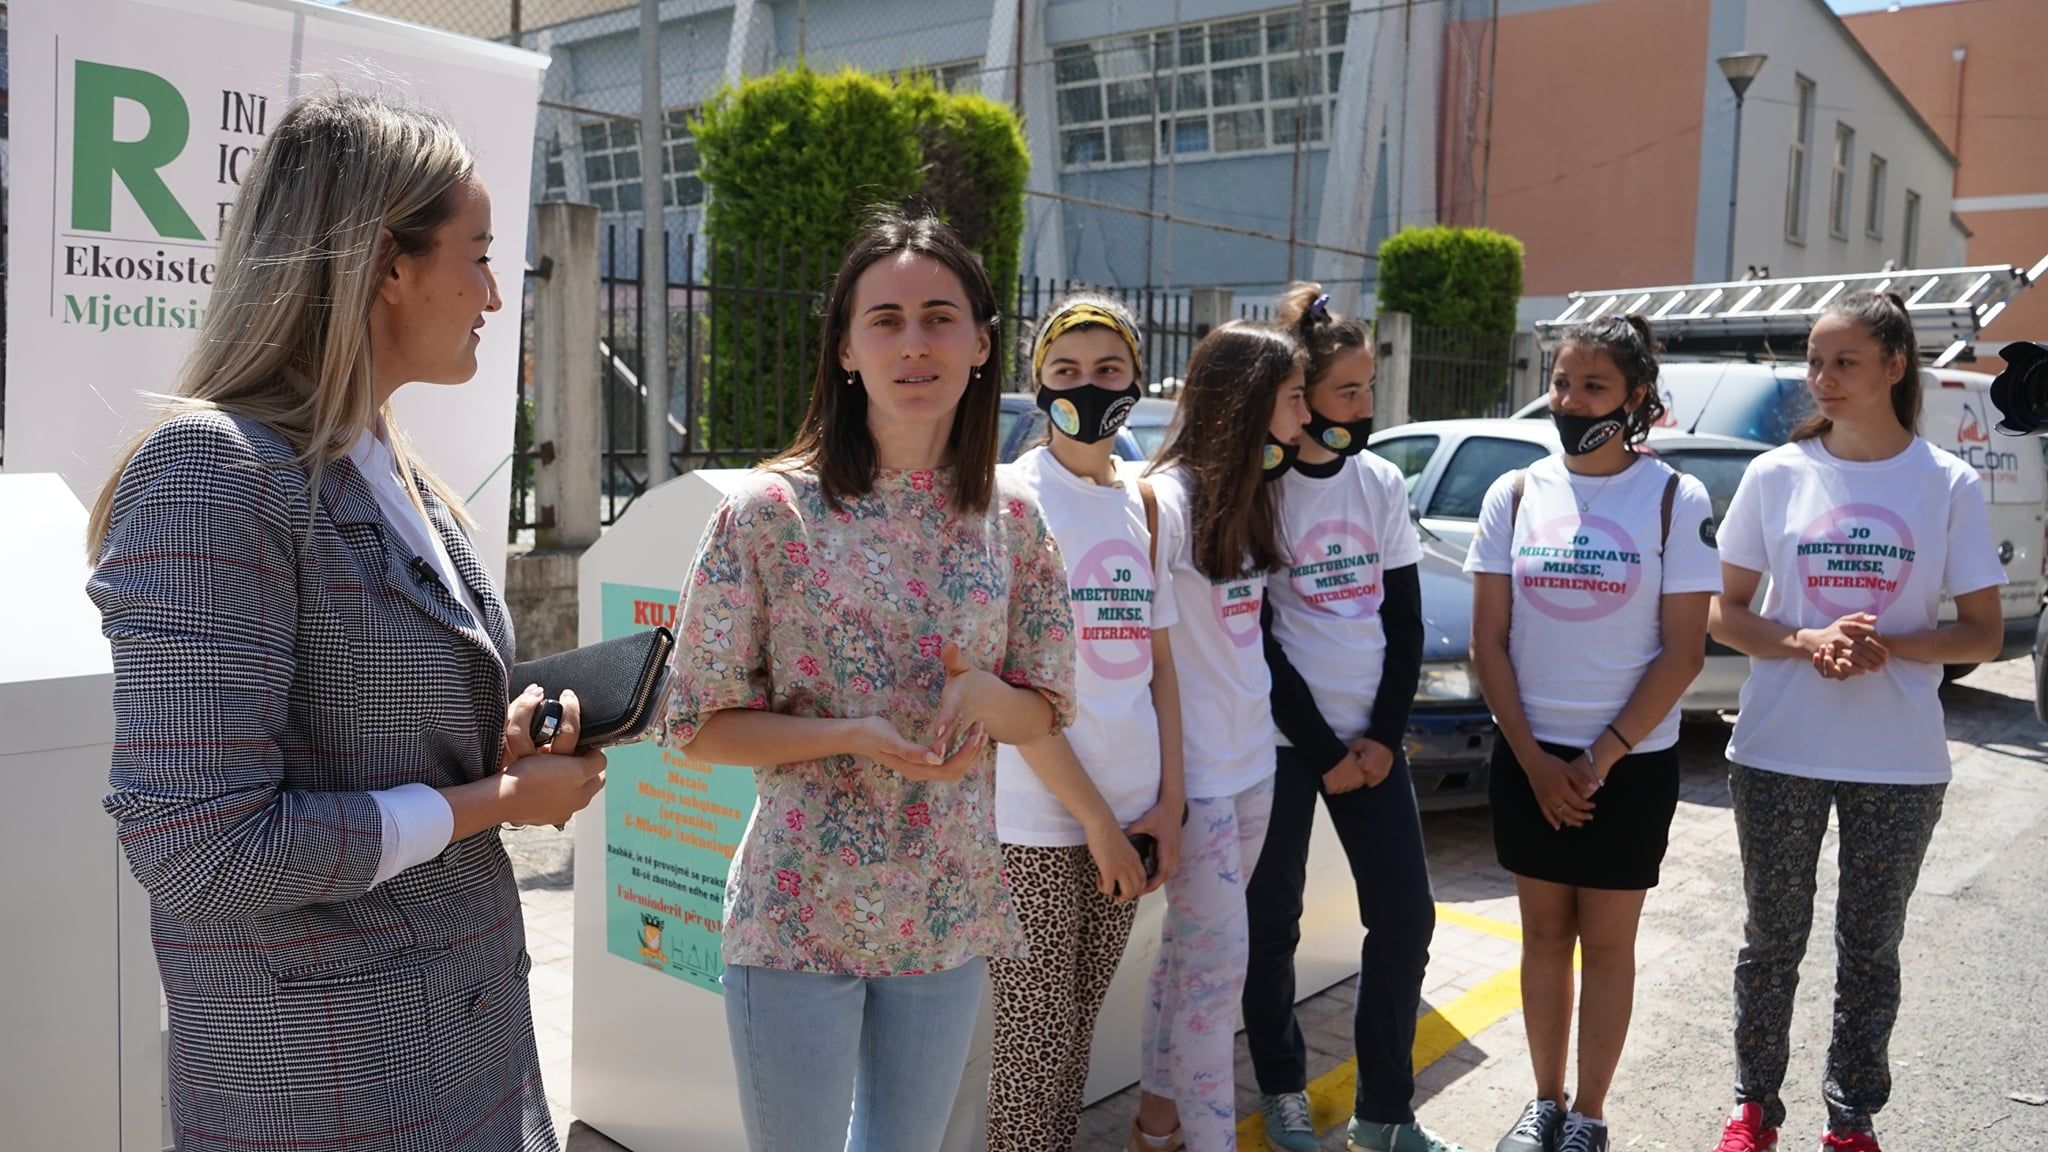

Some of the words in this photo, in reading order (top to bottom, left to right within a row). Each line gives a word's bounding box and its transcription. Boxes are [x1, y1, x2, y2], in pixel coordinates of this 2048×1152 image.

[71, 59, 207, 241] R
[217, 144, 261, 186] IC
[1568, 535, 1589, 545] JO
[1848, 527, 1871, 539] JO
[1326, 543, 1342, 556] JO
[1519, 546, 1641, 564] MBETURINAVE
[1797, 542, 1916, 563] MBETURINAVE
[1112, 568, 1131, 582] JO
[1542, 561, 1605, 578] MIKSE,
[1827, 559, 1885, 575] MIKSE,
[1523, 576, 1627, 594] DIFERENCO!
[1807, 576, 1898, 592] DIFERENCO!
[1097, 607, 1144, 623] MIKSE,
[617, 884, 682, 918] Faleminderit
